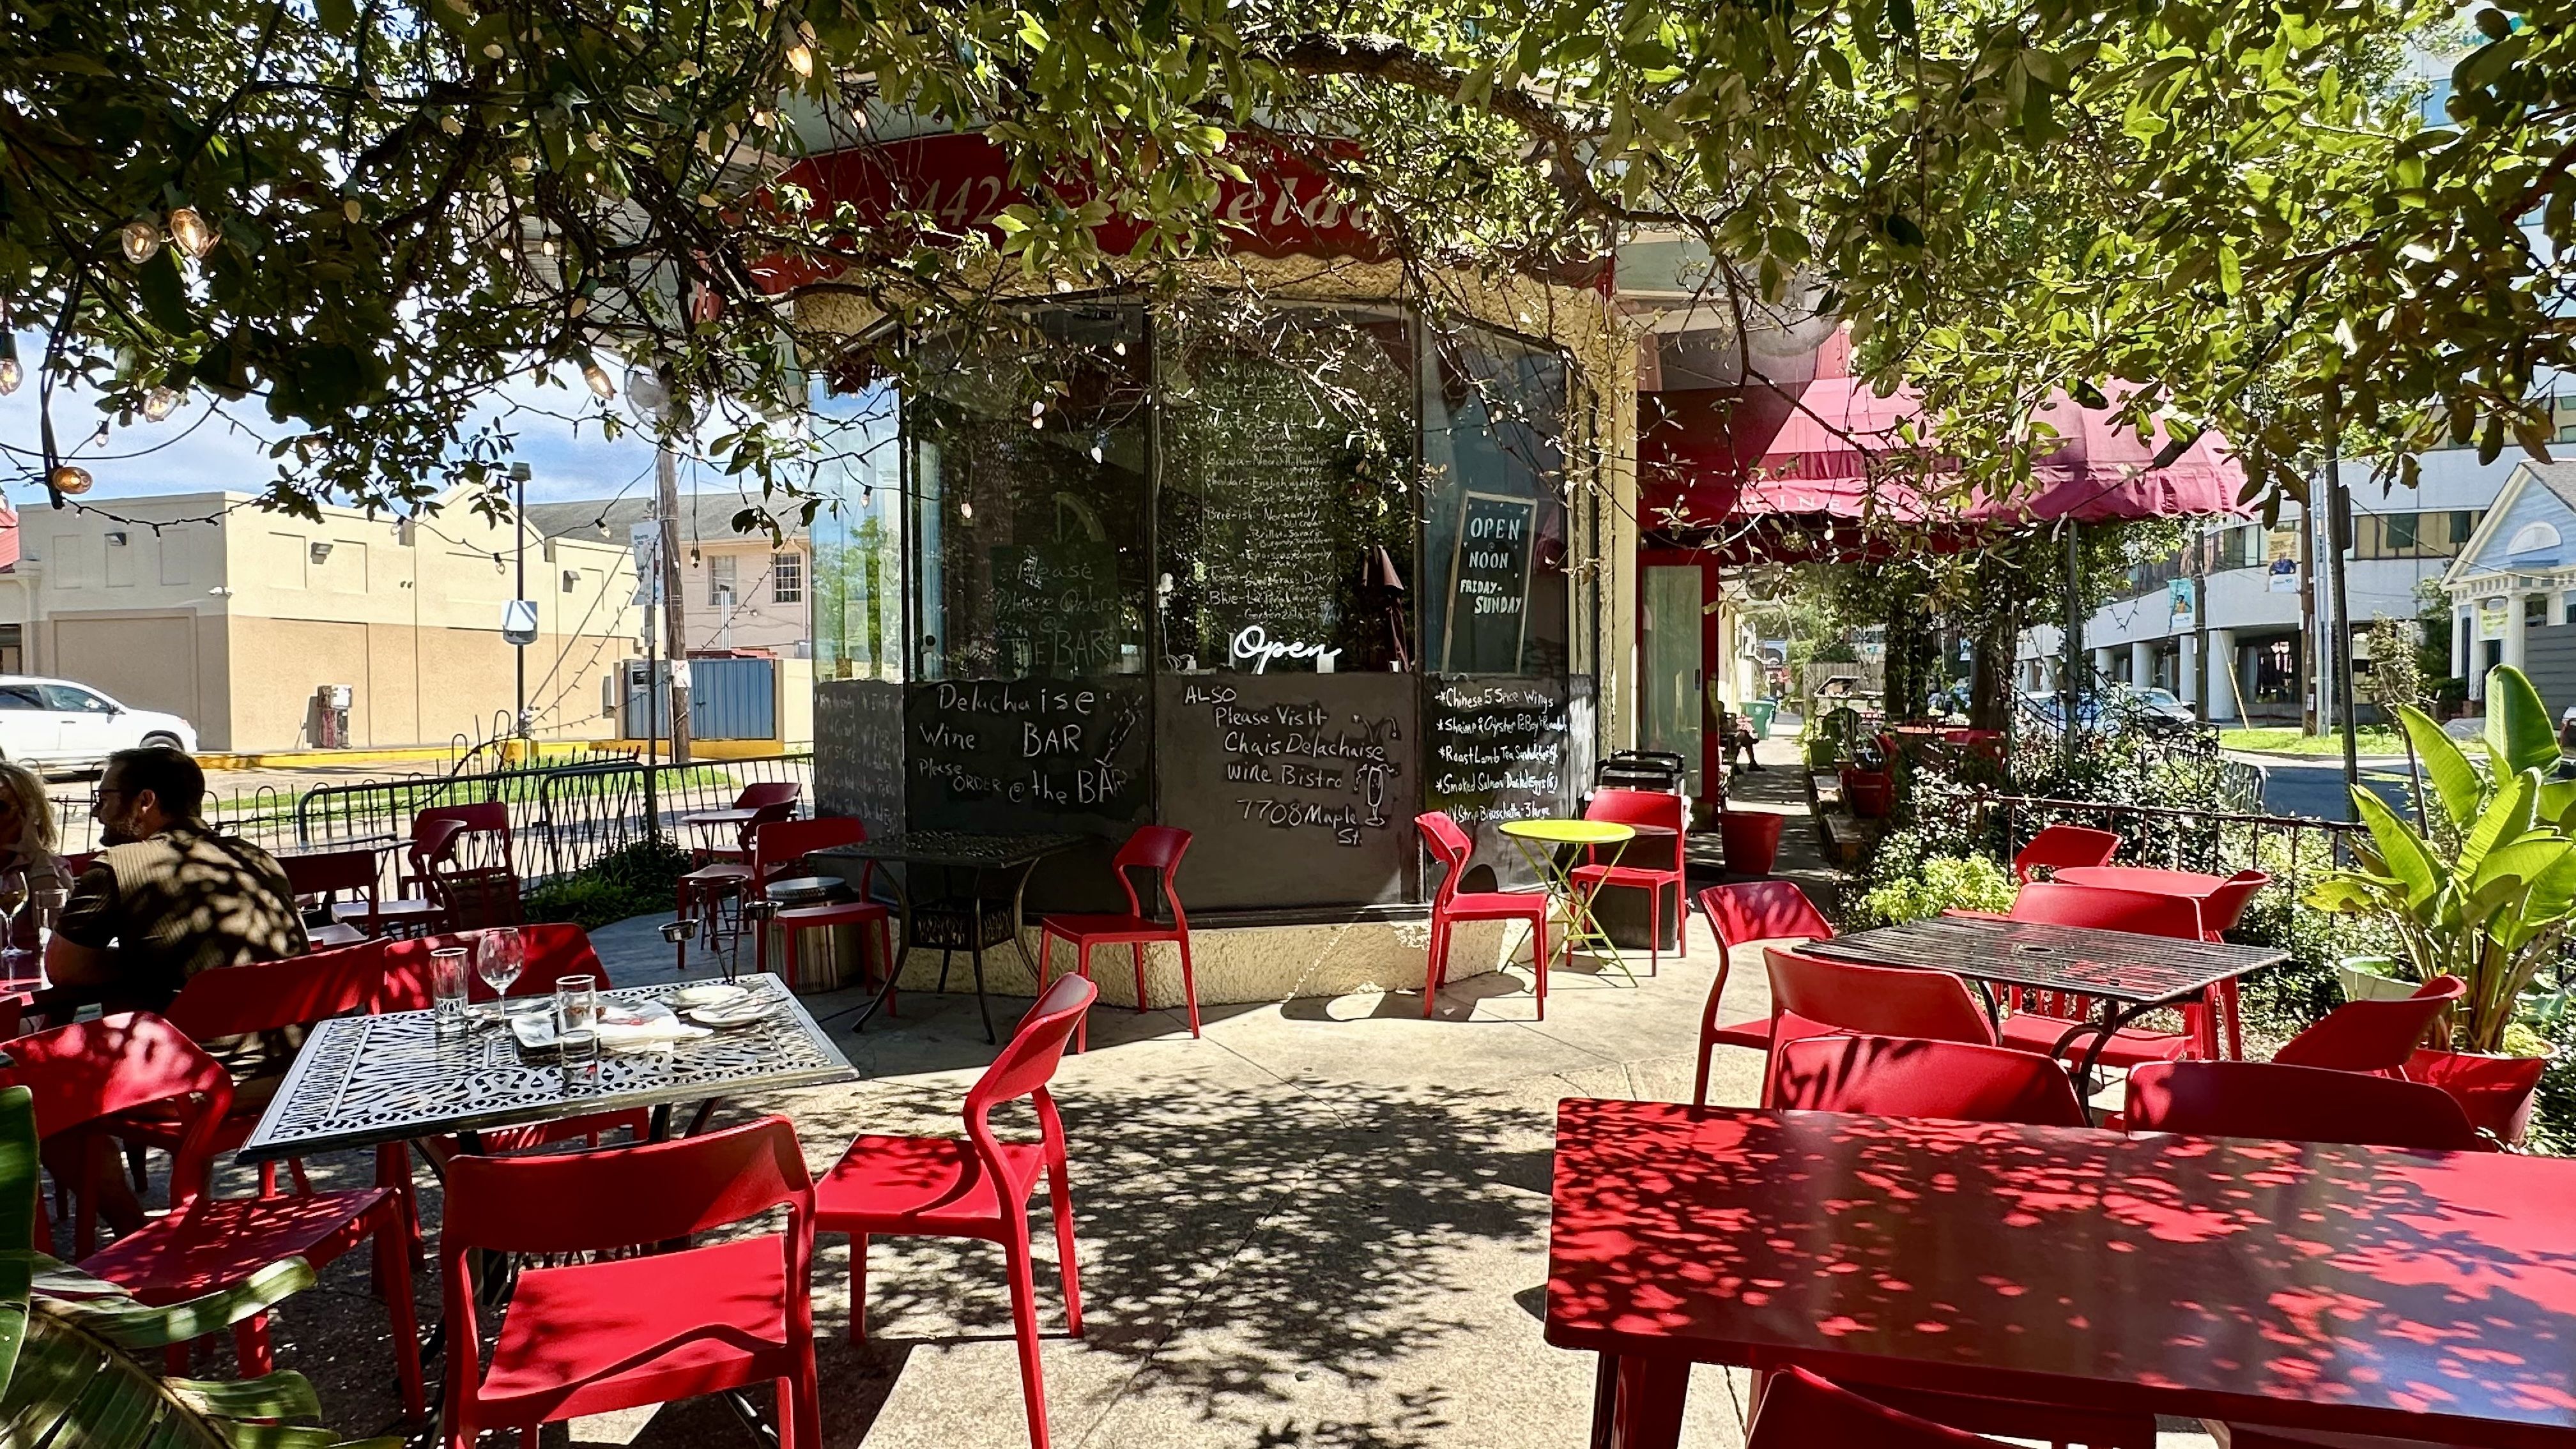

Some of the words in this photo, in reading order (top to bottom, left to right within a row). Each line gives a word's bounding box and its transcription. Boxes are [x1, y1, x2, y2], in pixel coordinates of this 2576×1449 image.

[1470, 518, 1521, 541] OPEN
[1468, 551, 1509, 569] NOON
[1474, 595, 1522, 614] SUNDAY
[1234, 625, 1342, 675] Open
[937, 683, 1095, 716] Delachaise
[1185, 685, 1238, 704] ALSO
[1483, 687, 1493, 704] 5
[1523, 689, 1554, 714] Wings
[1215, 706, 1271, 728] Please
[1276, 704, 1328, 726] Visit
[919, 722, 976, 750] Wine
[1023, 721, 1082, 758] BAR
[1224, 731, 1282, 757] Chais
[1285, 730, 1385, 762] Delachaise
[919, 757, 963, 779] Please
[1281, 764, 1342, 789] Bistro
[953, 775, 1002, 792] ORDER
[1031, 769, 1068, 805] the
[1077, 767, 1130, 804] BAR
[1236, 799, 1302, 827] 7708
[1303, 804, 1358, 829] Maple
